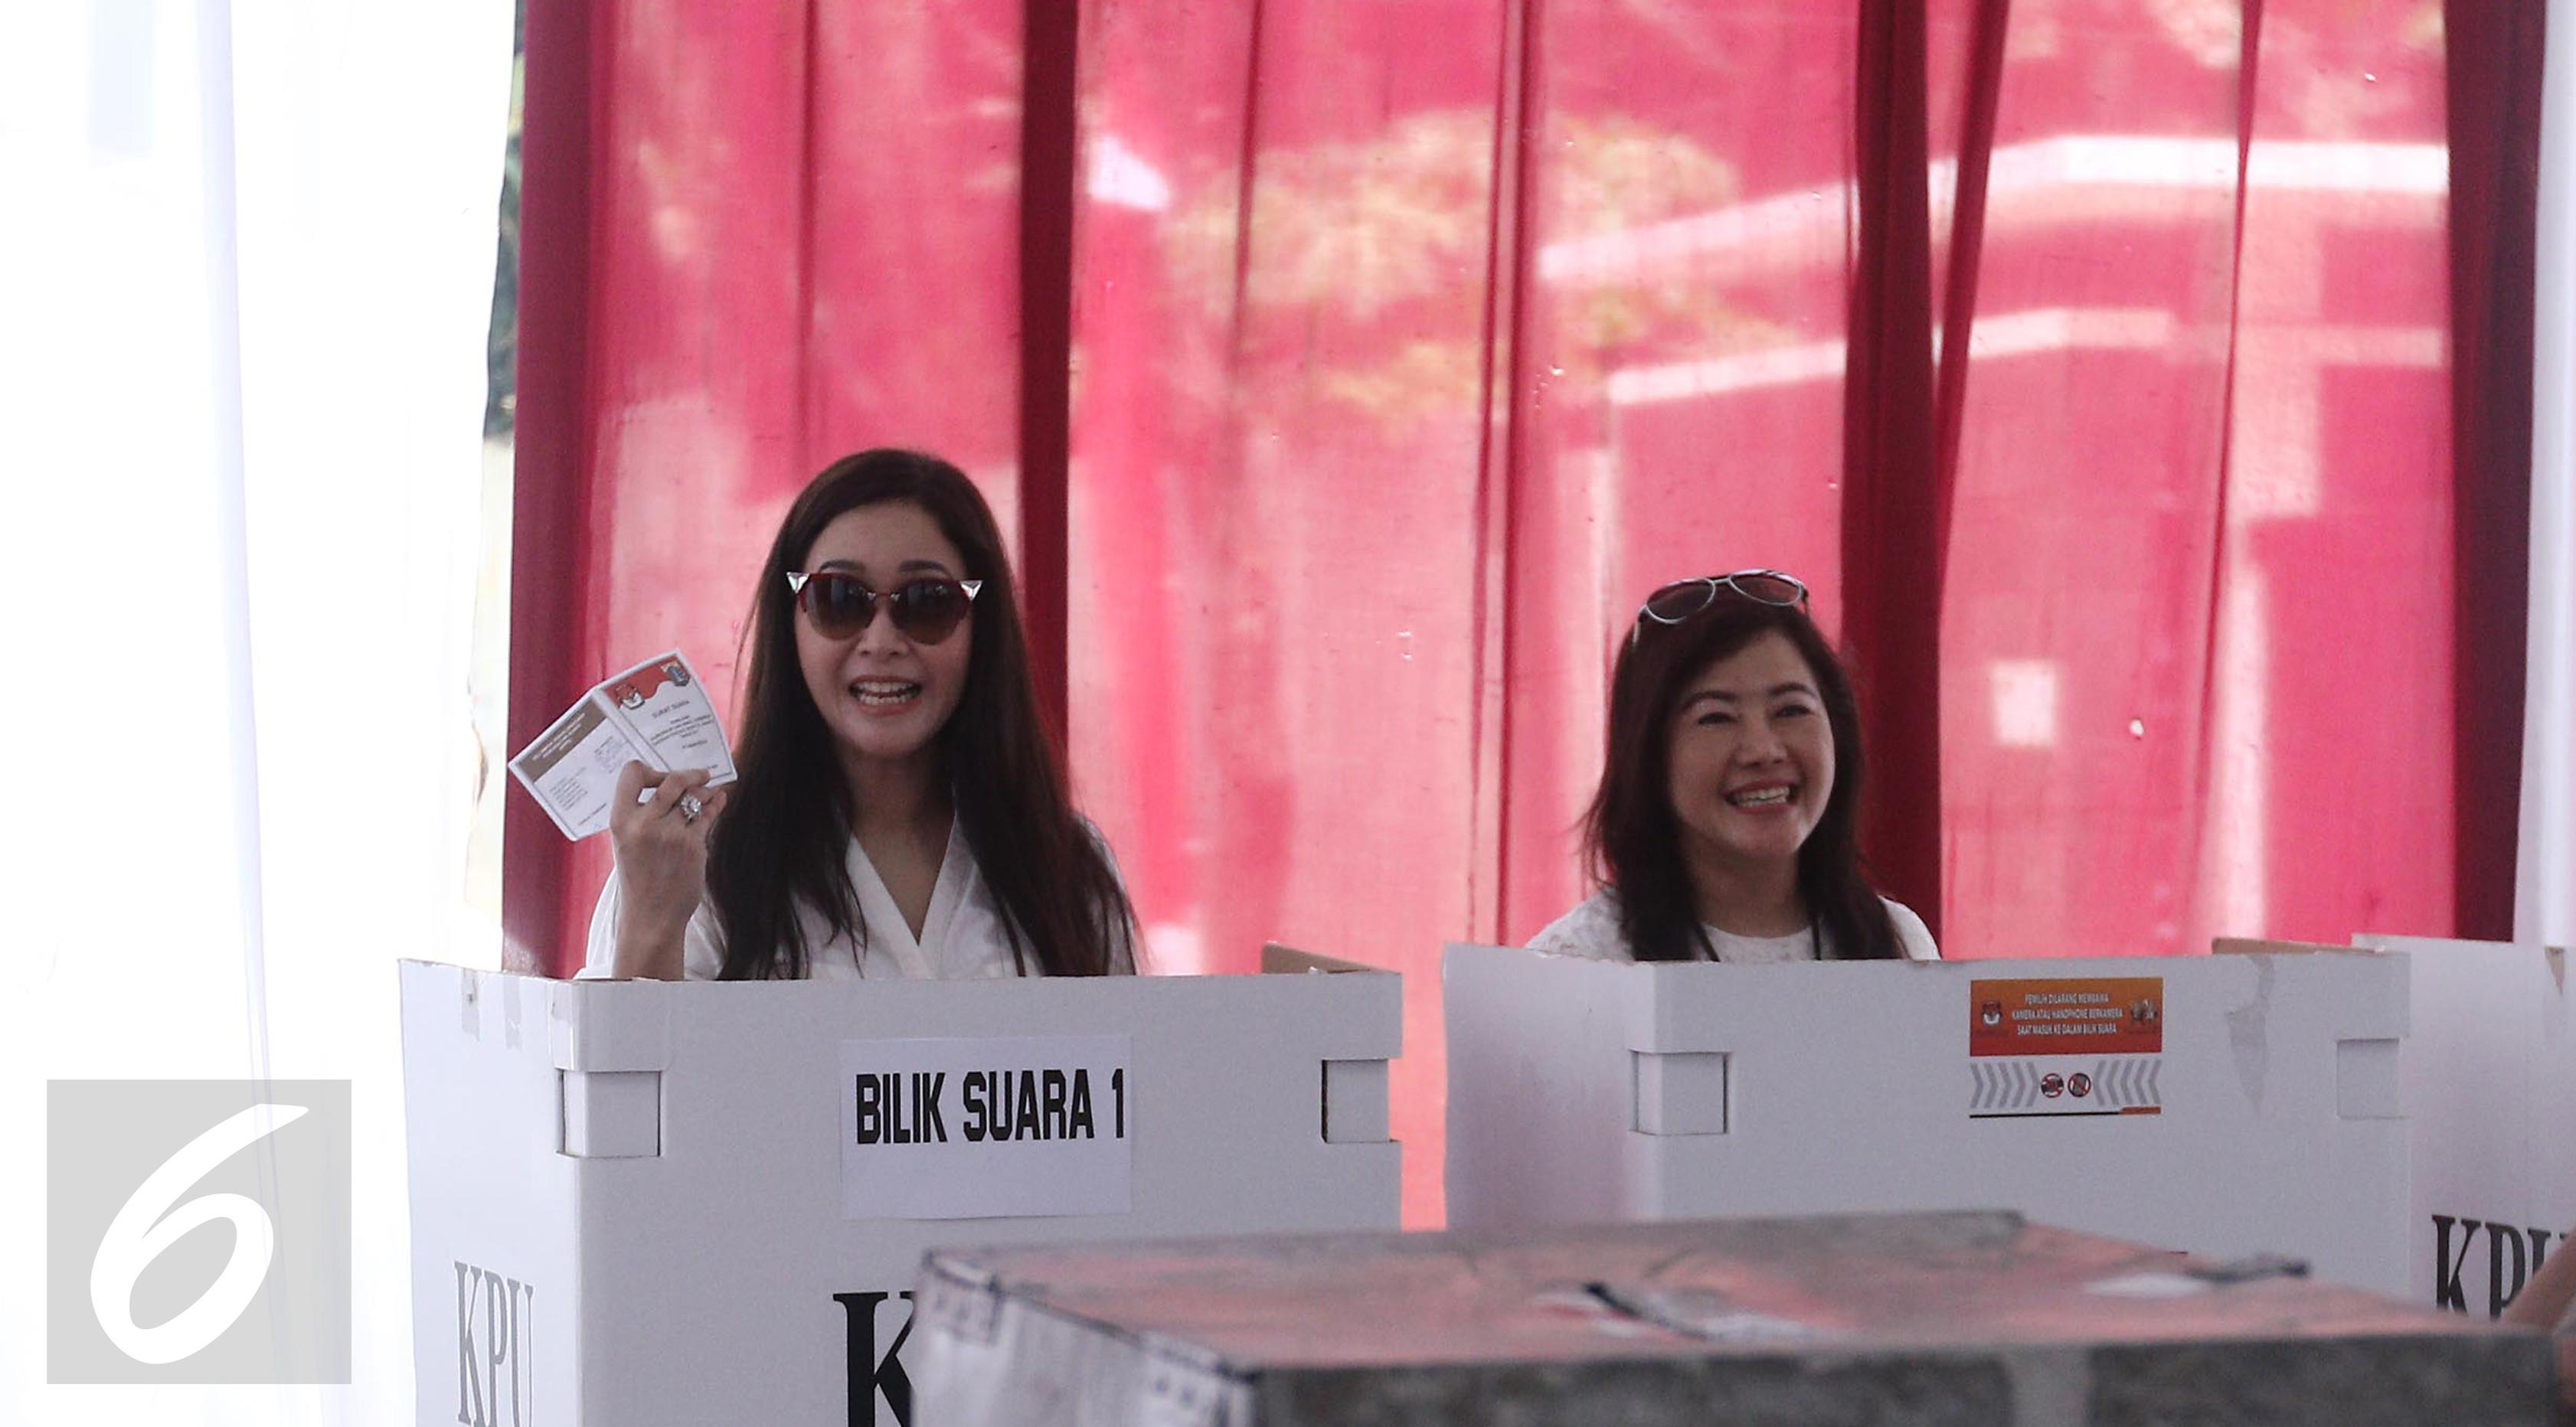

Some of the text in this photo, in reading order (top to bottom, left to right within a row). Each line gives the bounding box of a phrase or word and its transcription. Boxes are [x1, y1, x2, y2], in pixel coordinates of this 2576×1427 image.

[2012, 1007, 2123, 1020] KAMERA ATAU HANDPHONE BERKAMERA
[2048, 994, 2077, 1004] DILARANG
[2078, 993, 2109, 1003] MEMBAWA
[2018, 1025, 2032, 1035] SAAT
[2032, 1024, 2053, 1034] MASUK
[2054, 1024, 2061, 1034] KE
[2061, 1024, 2083, 1034] DALAM
[2084, 1024, 2097, 1034] BILIK
[2097, 1023, 2117, 1033] SUARA
[856, 1068, 1124, 1145] BILIK SUARA 1
[2431, 1214, 2568, 1320] KP
[453, 1260, 534, 1427] KPU
